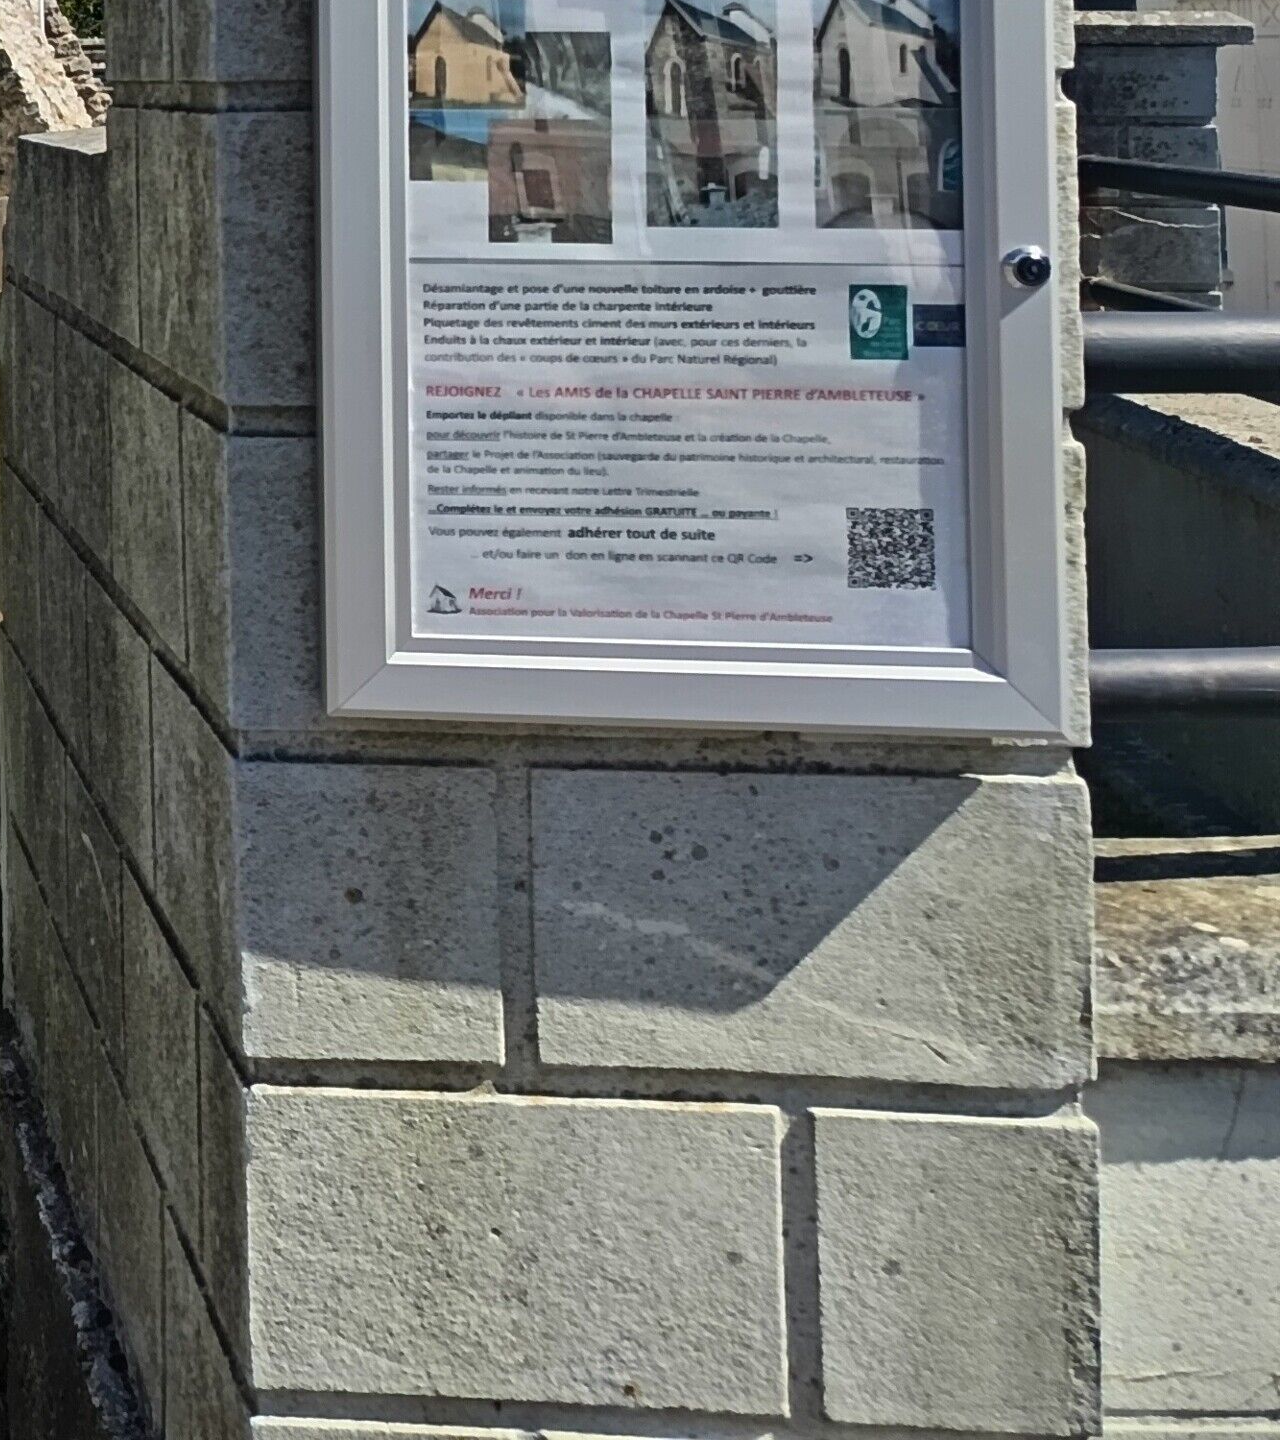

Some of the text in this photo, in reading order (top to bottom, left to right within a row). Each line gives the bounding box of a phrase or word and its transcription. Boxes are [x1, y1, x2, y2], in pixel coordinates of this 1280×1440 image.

[423, 284, 503, 295] Désamiantage
[507, 284, 518, 293] et
[522, 286, 549, 295] pose
[589, 284, 638, 294] nouvelle
[641, 285, 681, 294] toiture
[703, 284, 745, 294] ardoise
[762, 285, 816, 297] gouttière
[423, 301, 485, 312] Réparation
[524, 302, 559, 312] partie
[562, 301, 576, 311] de
[579, 301, 589, 311] la
[593, 302, 651, 312] charpente
[655, 302, 713, 311] intérieure
[424, 318, 480, 329] Piquetage
[484, 319, 503, 328] des
[582, 319, 621, 328] ciment
[625, 319, 645, 329] des
[648, 321, 678, 329] murs
[681, 320, 739, 329] extérieurs
[743, 320, 754, 329] et
[758, 320, 815, 330] intérieurs
[424, 335, 466, 345] Enduits
[470, 335, 476, 345] à
[480, 335, 489, 345] la
[493, 335, 526, 345] chaux
[530, 335, 581, 345] extérieur
[585, 336, 596, 345] et
[600, 336, 650, 346] intérieur
[691, 339, 717, 348] pour
[721, 339, 739, 347] ces
[797, 338, 807, 347] la
[426, 385, 501, 398] REJOIGNEZ
[529, 387, 550, 398] Les
[554, 387, 591, 398] AMIS
[595, 387, 612, 398] de
[616, 387, 628, 398] la
[633, 388, 701, 399] CHAPELLE
[706, 388, 748, 400] SAINT
[752, 388, 800, 400] PIERRE
[429, 526, 715, 540] Vous pouvez également adhérer tout de suite
[469, 588, 512, 600] Merci
